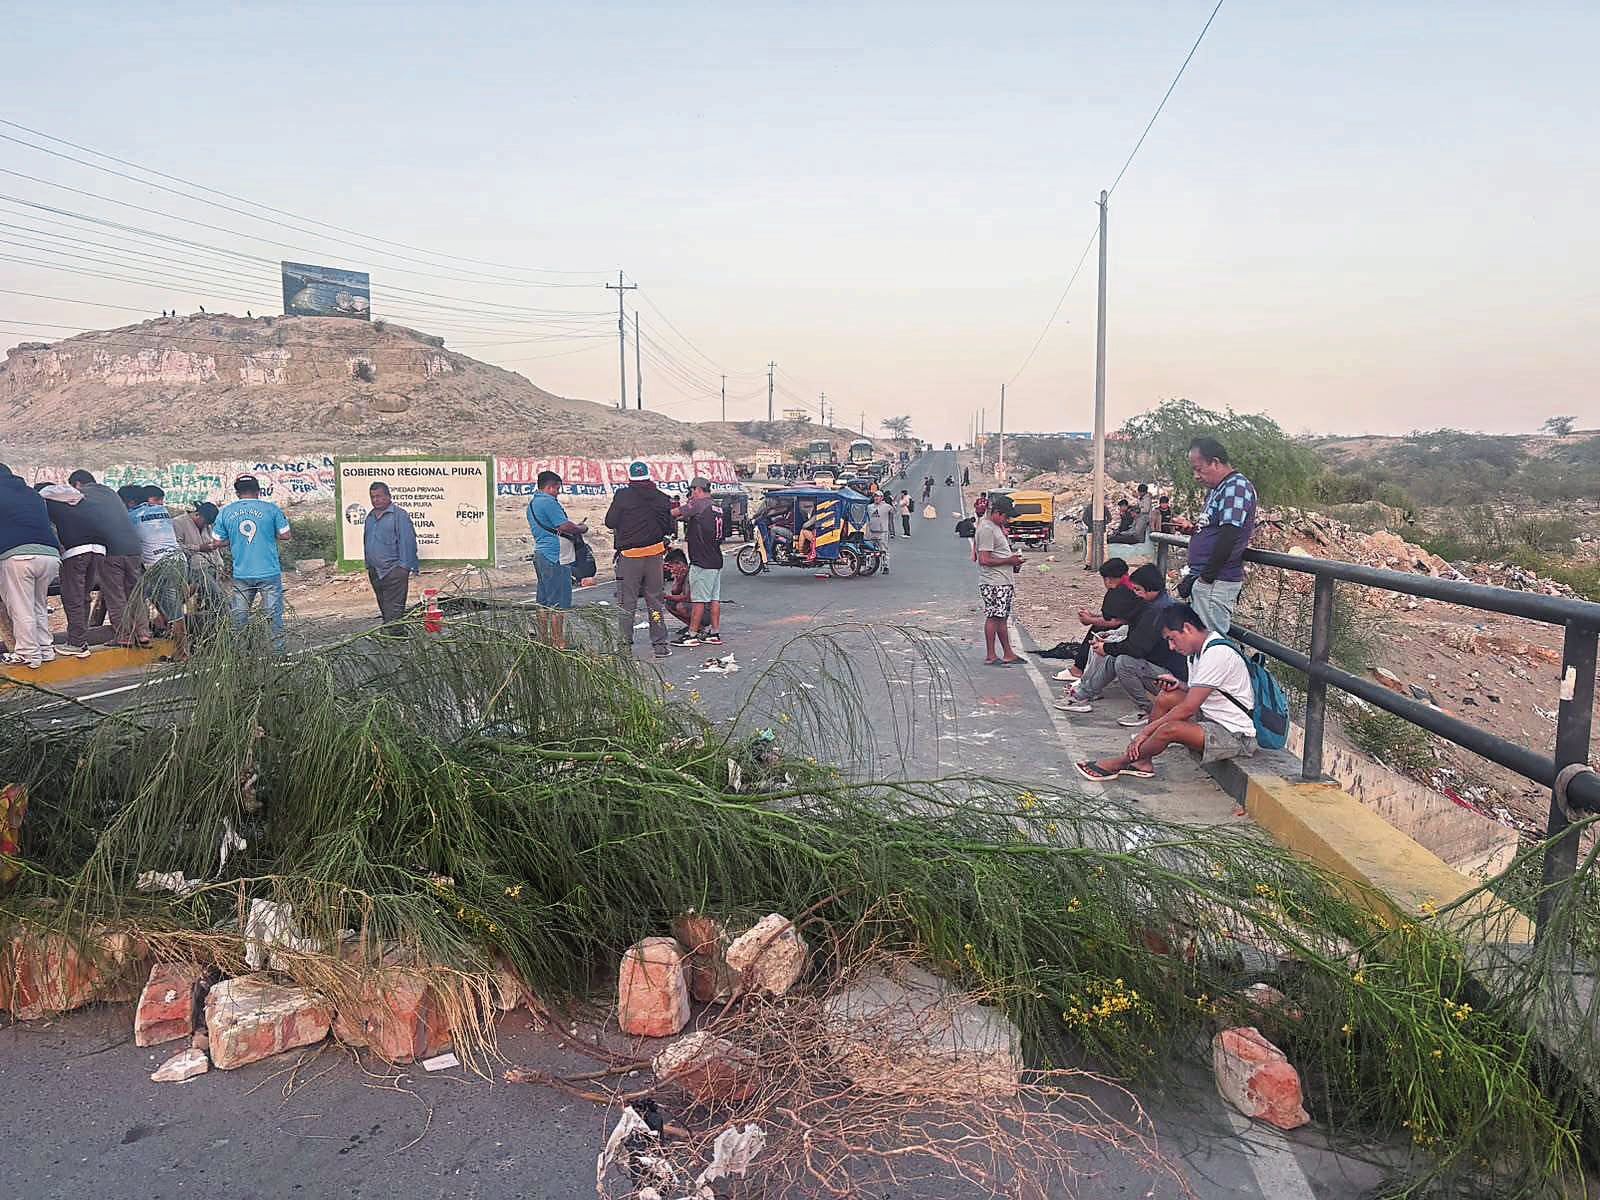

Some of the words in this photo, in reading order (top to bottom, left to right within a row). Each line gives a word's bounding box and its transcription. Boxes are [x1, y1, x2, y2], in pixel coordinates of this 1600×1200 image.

[343, 468, 395, 477] GOBIERNO
[397, 467, 449, 476] REGIONAL
[451, 467, 482, 476] PIURA
[609, 461, 686, 482] CVA
[239, 519, 257, 544] 9
